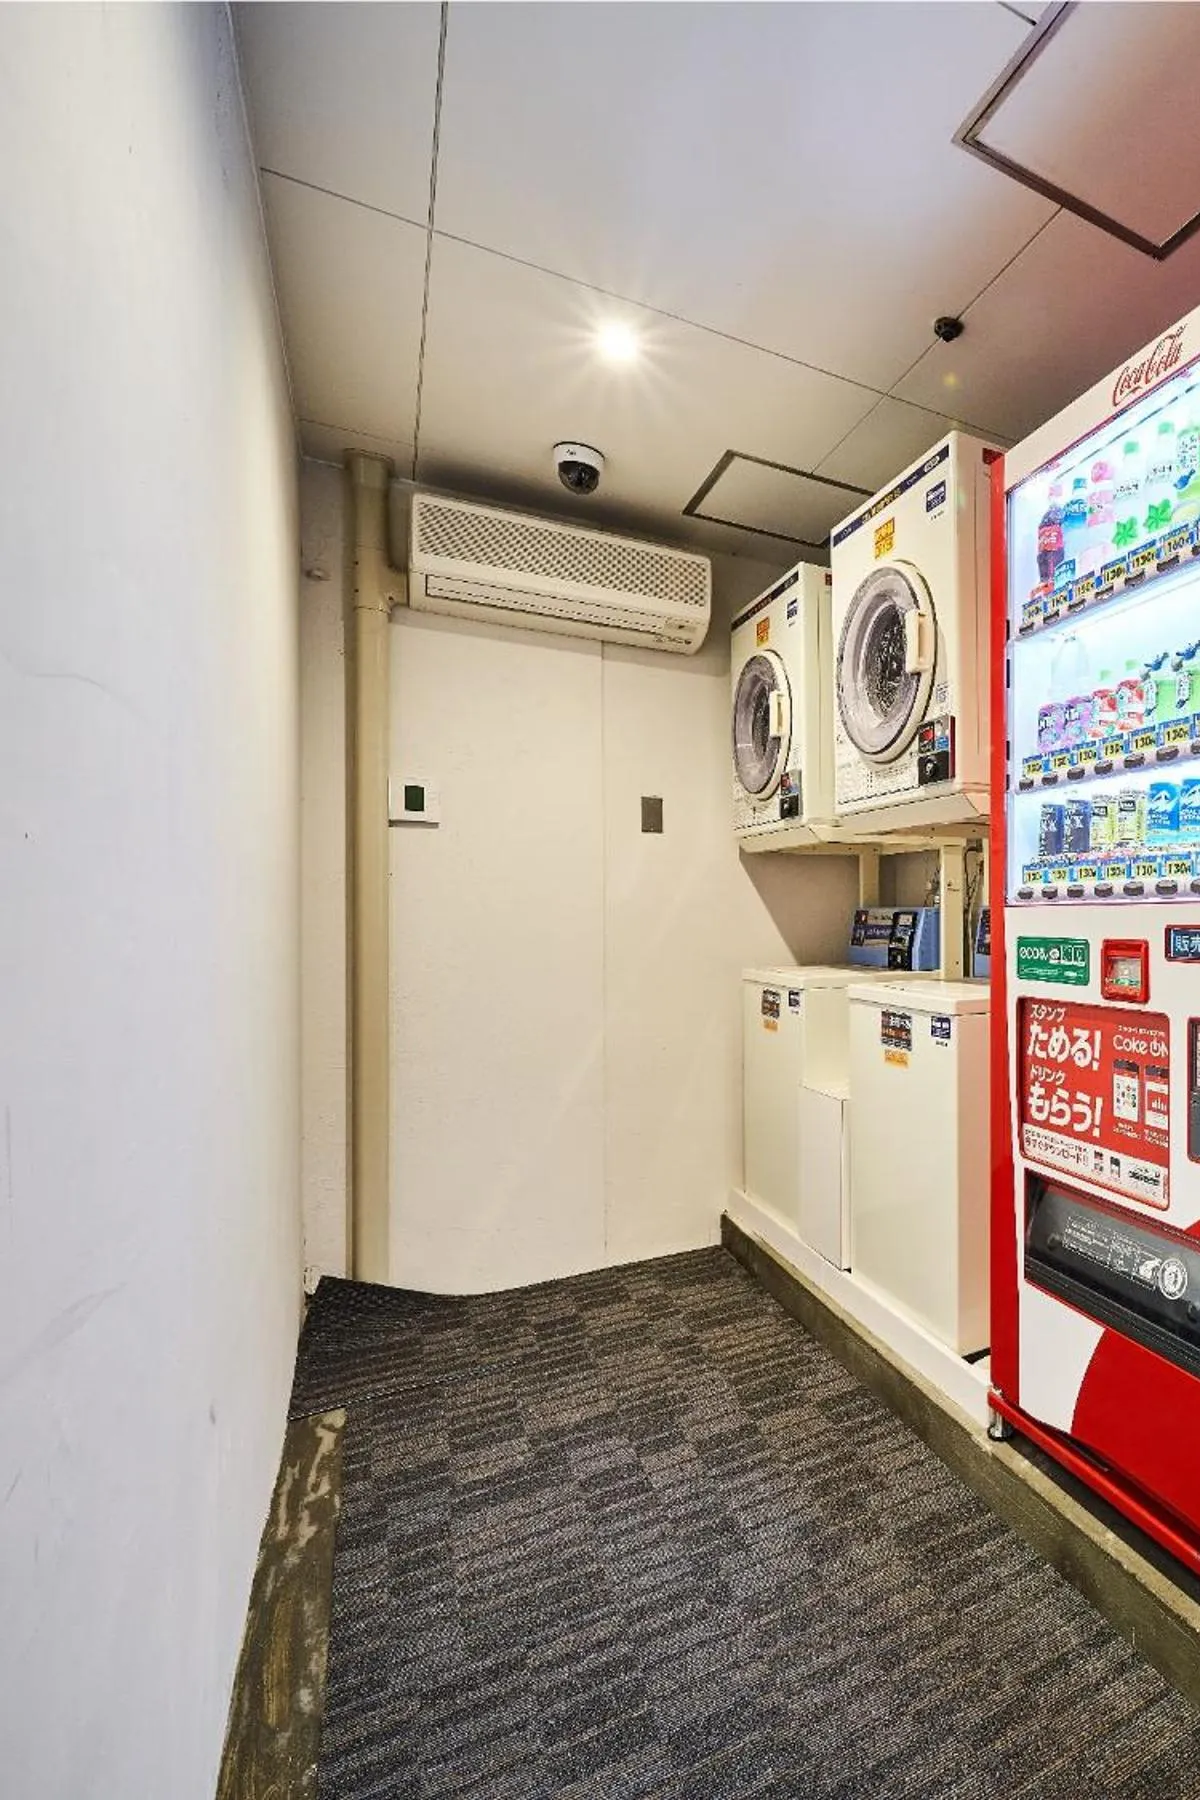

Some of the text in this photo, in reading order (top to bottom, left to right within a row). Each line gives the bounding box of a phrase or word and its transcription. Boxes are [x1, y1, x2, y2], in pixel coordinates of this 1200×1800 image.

[1112, 323, 1188, 406] Coca-Cola
[1030, 1003, 1067, 1022] スタンプ
[1027, 1020, 1102, 1072] ためる!
[1112, 1034, 1148, 1056] Coke
[1029, 1064, 1066, 1086] ドリンク
[1028, 1081, 1103, 1138] もらう!
